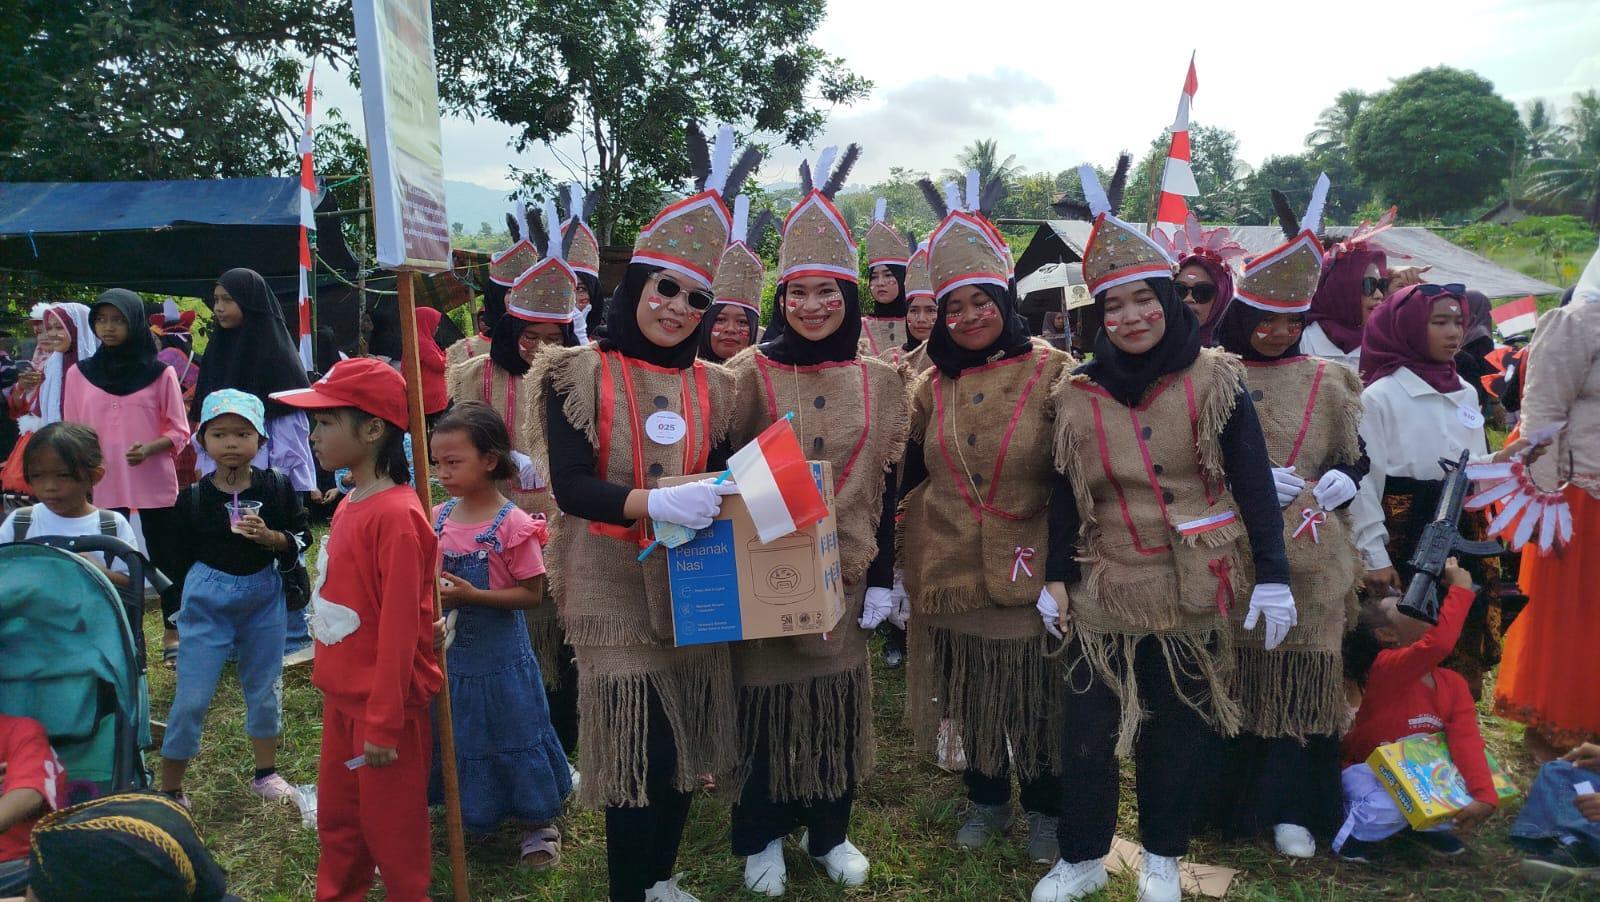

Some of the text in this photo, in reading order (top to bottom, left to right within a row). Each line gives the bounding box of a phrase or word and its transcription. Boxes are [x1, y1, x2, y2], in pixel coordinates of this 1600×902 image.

[658, 422, 676, 432] 025
[675, 542, 728, 558] Penanak
[676, 558, 704, 573] Nasi
[781, 614, 793, 625] SNI
